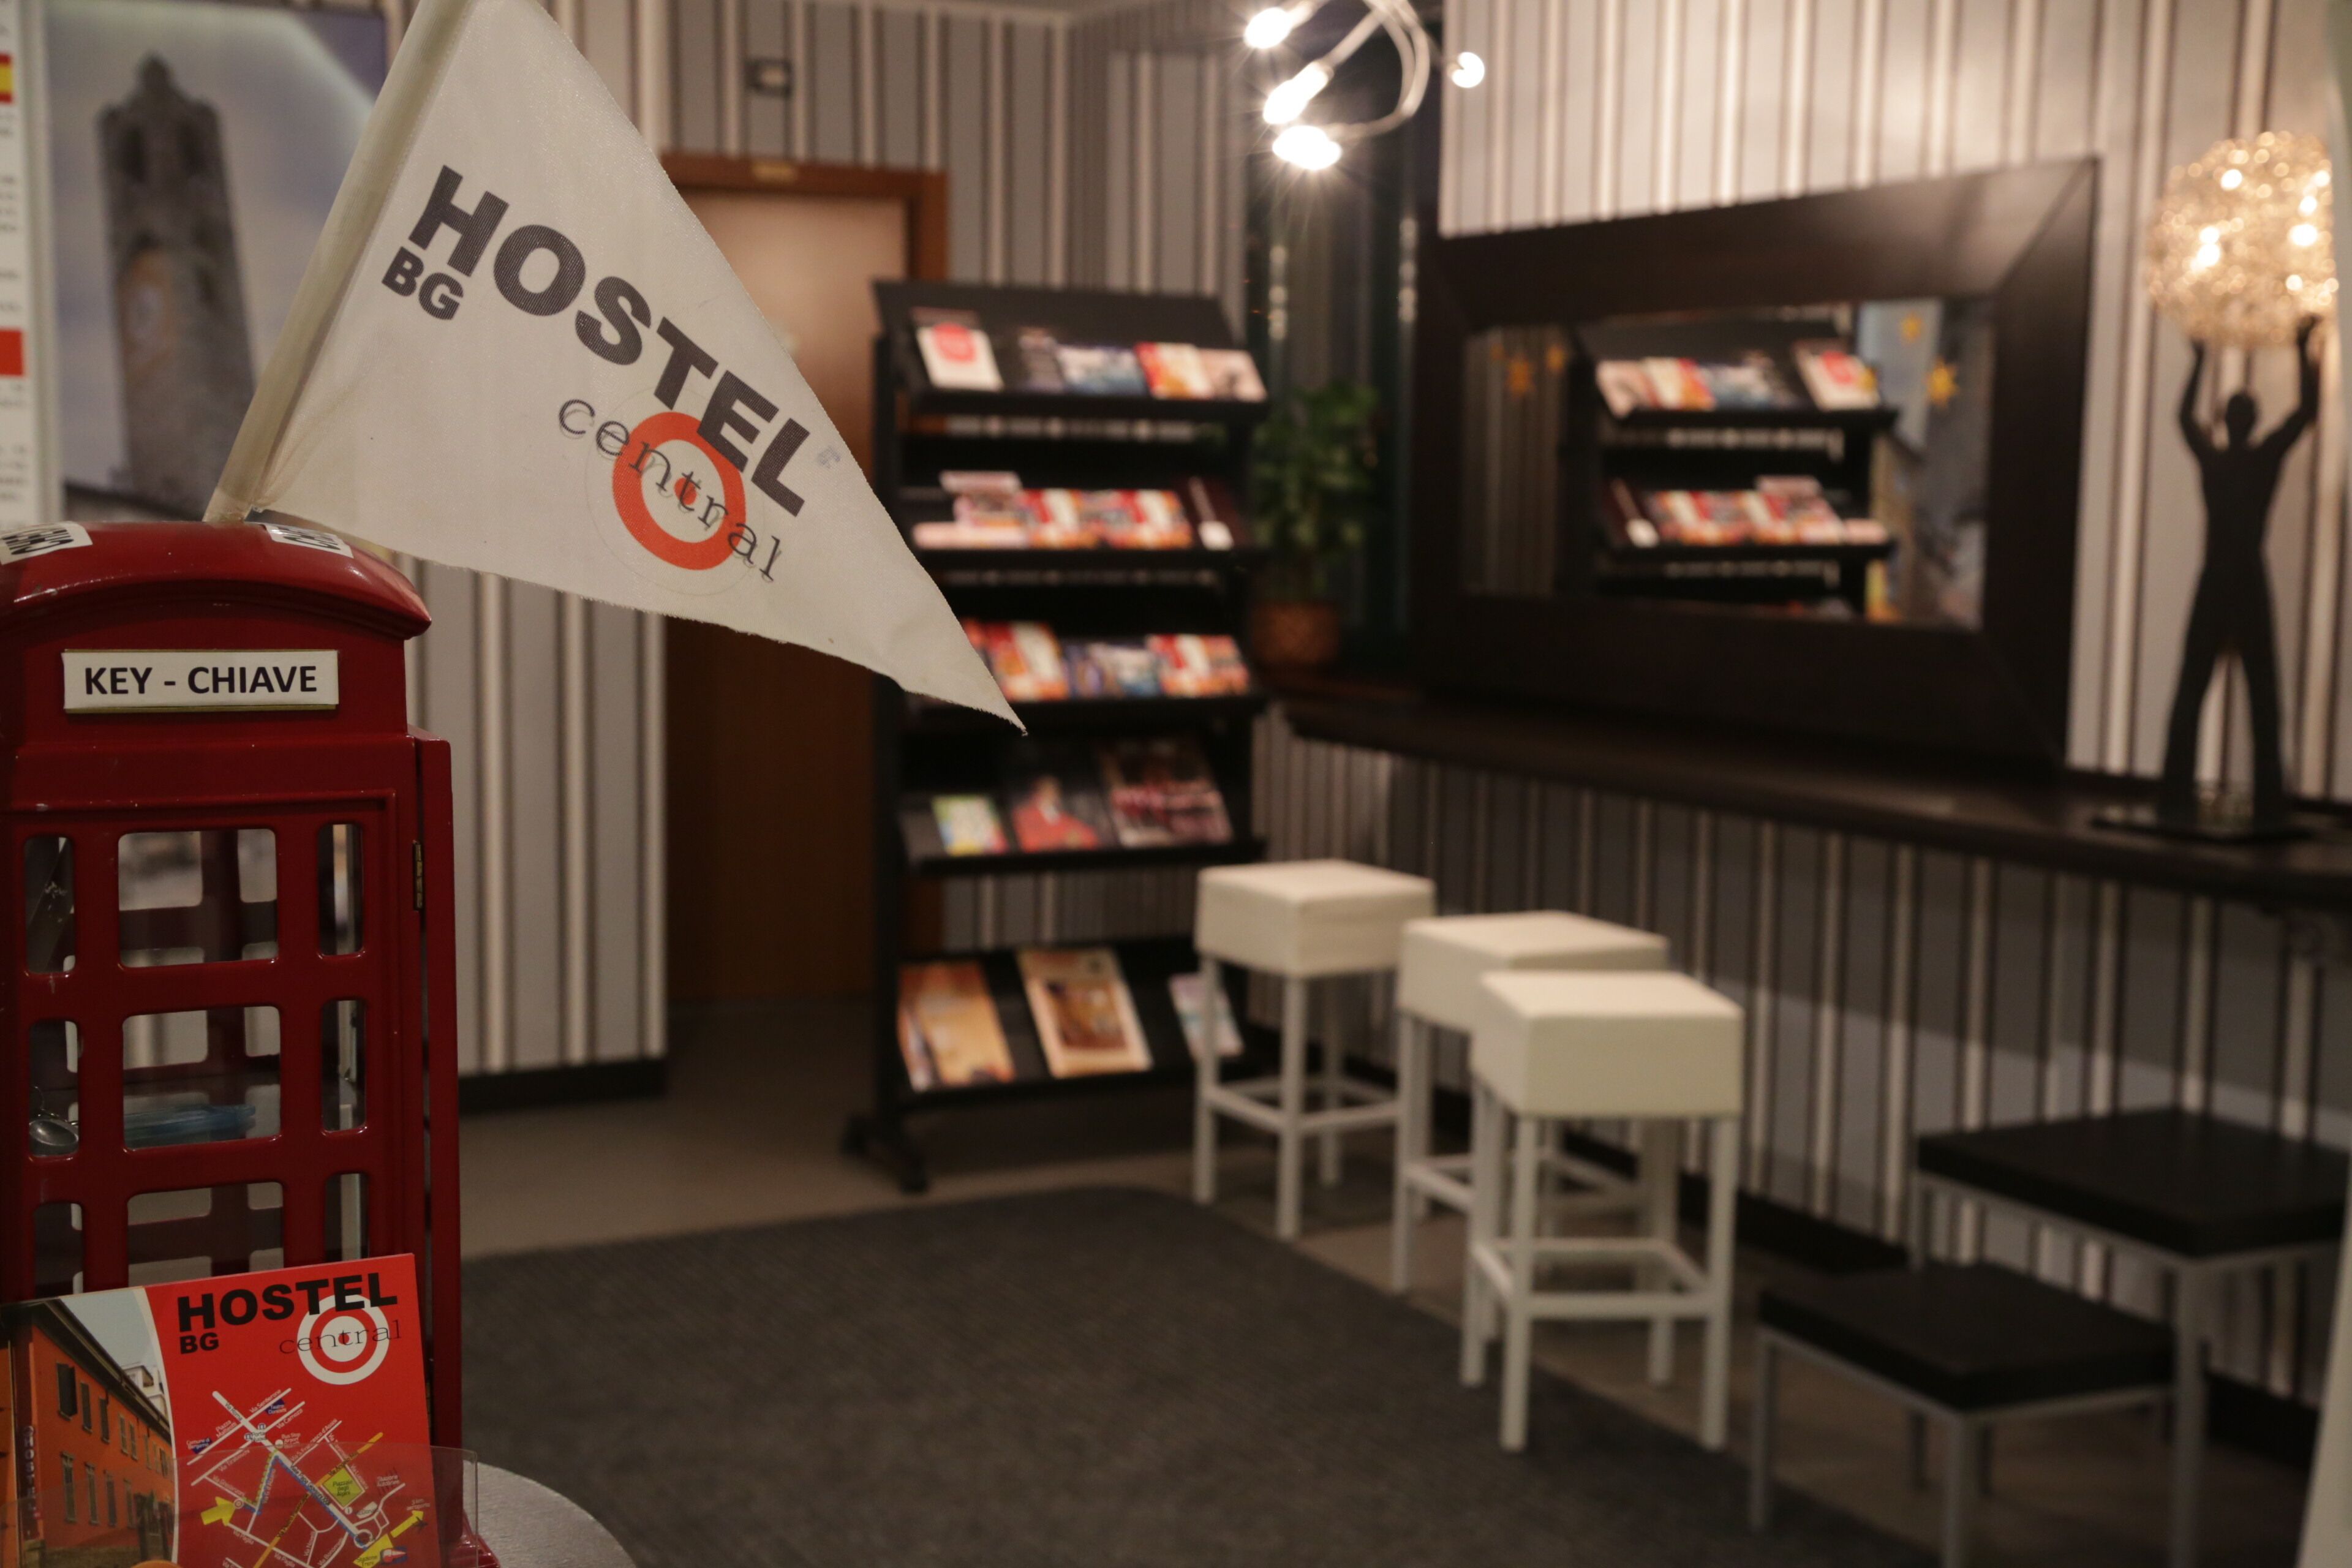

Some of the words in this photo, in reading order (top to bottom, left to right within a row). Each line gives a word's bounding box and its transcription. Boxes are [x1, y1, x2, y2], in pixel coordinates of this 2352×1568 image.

[381, 246, 464, 320] BG
[408, 164, 810, 517] HOSTEL
[558, 399, 780, 582] central
[85, 667, 153, 695] KEY
[187, 665, 318, 693] CHIAVE
[177, 1272, 398, 1332] HOSTEL
[179, 1332, 219, 1354] BG
[279, 1319, 401, 1354] central
